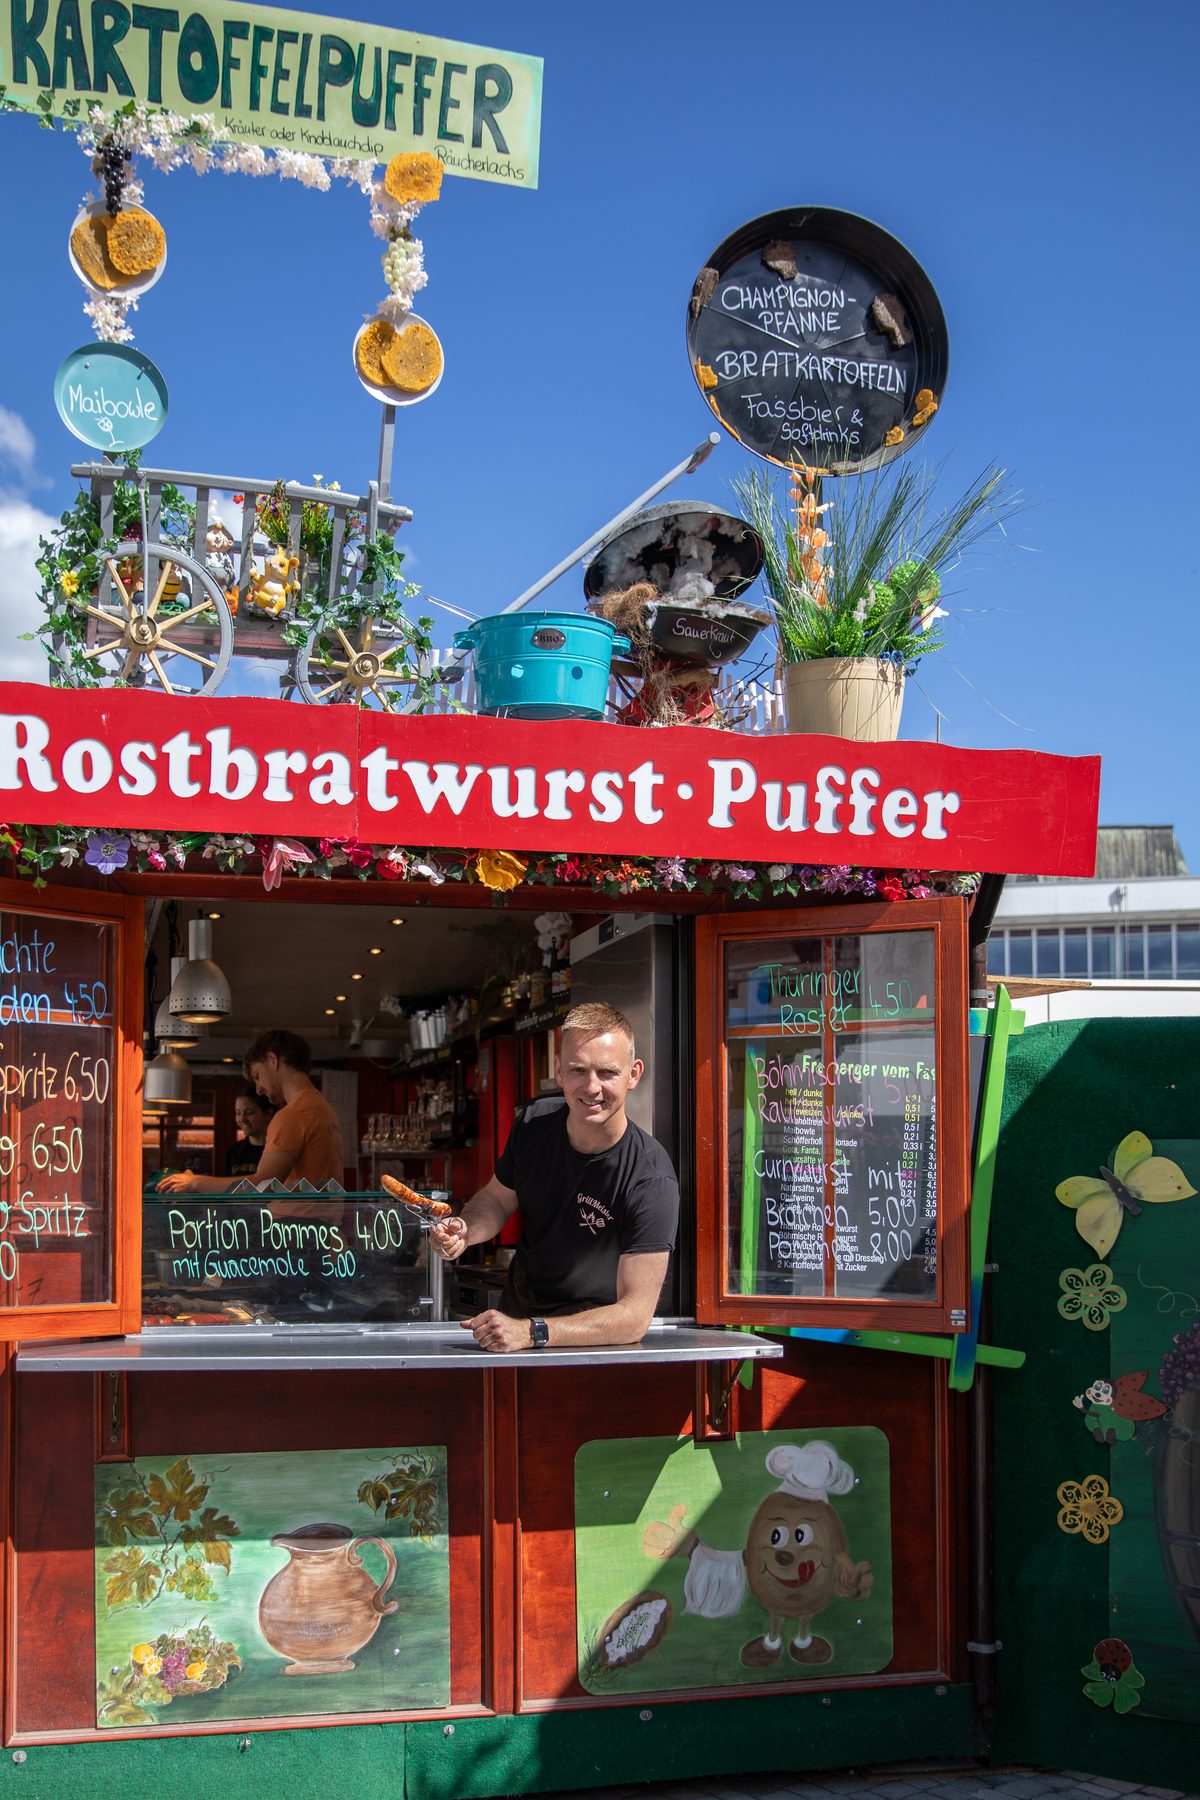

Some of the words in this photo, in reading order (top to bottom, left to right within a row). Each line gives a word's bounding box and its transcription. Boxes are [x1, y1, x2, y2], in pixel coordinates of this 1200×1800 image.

[9, 0, 516, 156] KARTOFFELPUFFER
[223, 116, 266, 137] Kräuter
[268, 128, 296, 142] oder
[433, 143, 526, 181] Räucherlachs
[720, 284, 857, 311] CHAMPIGNON-
[758, 310, 841, 335] PFANNE
[715, 350, 907, 394] BRATKARTOFFELN
[69, 383, 159, 421] Maibowle
[740, 393, 845, 422] Fassbier
[850, 408, 864, 427] &
[780, 423, 861, 446] Softdrinks
[671, 617, 737, 645] Sauerkraut
[0, 712, 666, 826] Rostbratwurst
[707, 757, 961, 841] Puffer
[63, 980, 109, 1025] 4,50
[759, 963, 865, 1007] Thüringer
[868, 978, 914, 1018] 4,50
[64, 1051, 110, 1104] 6,50
[881, 1064, 910, 1079] vom
[32, 1122, 84, 1176] 6,50
[868, 1160, 904, 1191] mit
[18, 1190, 89, 1249] Spritz
[765, 1198, 850, 1227] Brötchen
[868, 1195, 917, 1228] 5,00
[167, 1208, 250, 1251] Portion
[260, 1207, 344, 1253] Pommes
[355, 1208, 403, 1251] 4,00
[768, 1231, 855, 1263] Pommes
[869, 1229, 913, 1262] 8,00
[172, 1249, 200, 1279] mit
[321, 1249, 357, 1279] 5,00
[845, 1263, 868, 1272] Zucker
